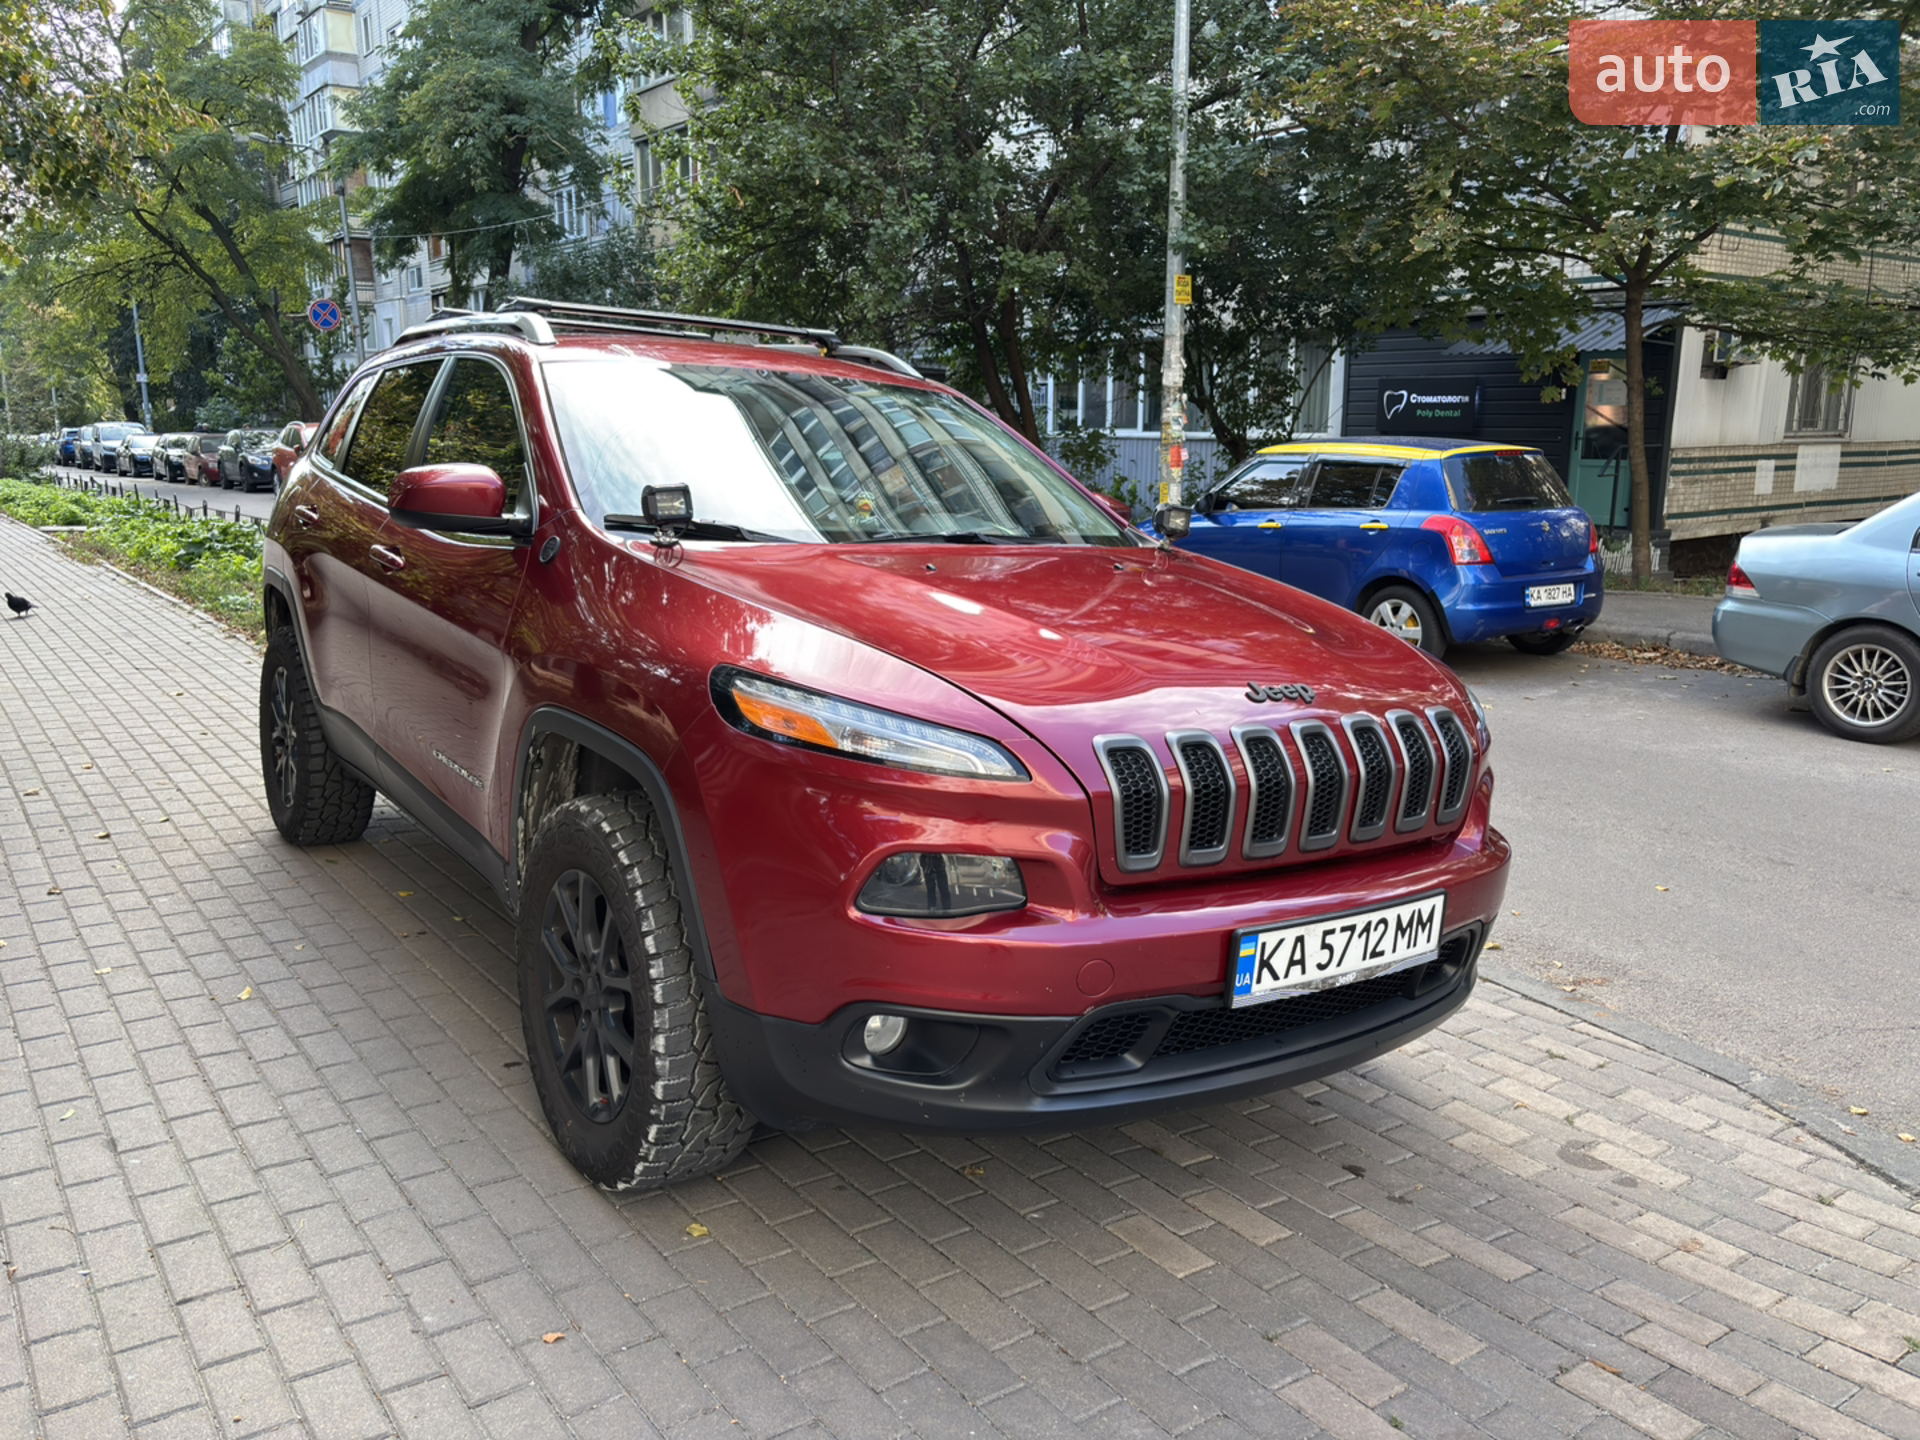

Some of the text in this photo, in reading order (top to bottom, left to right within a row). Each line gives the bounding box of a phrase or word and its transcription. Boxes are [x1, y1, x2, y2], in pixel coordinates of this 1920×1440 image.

[1416, 409, 1461, 418] Poly Dental
[1530, 589, 1542, 601] KA
[1244, 681, 1316, 704] Jeep
[1255, 903, 1437, 985] KA 5712 MM
[1235, 972, 1251, 987] UA
